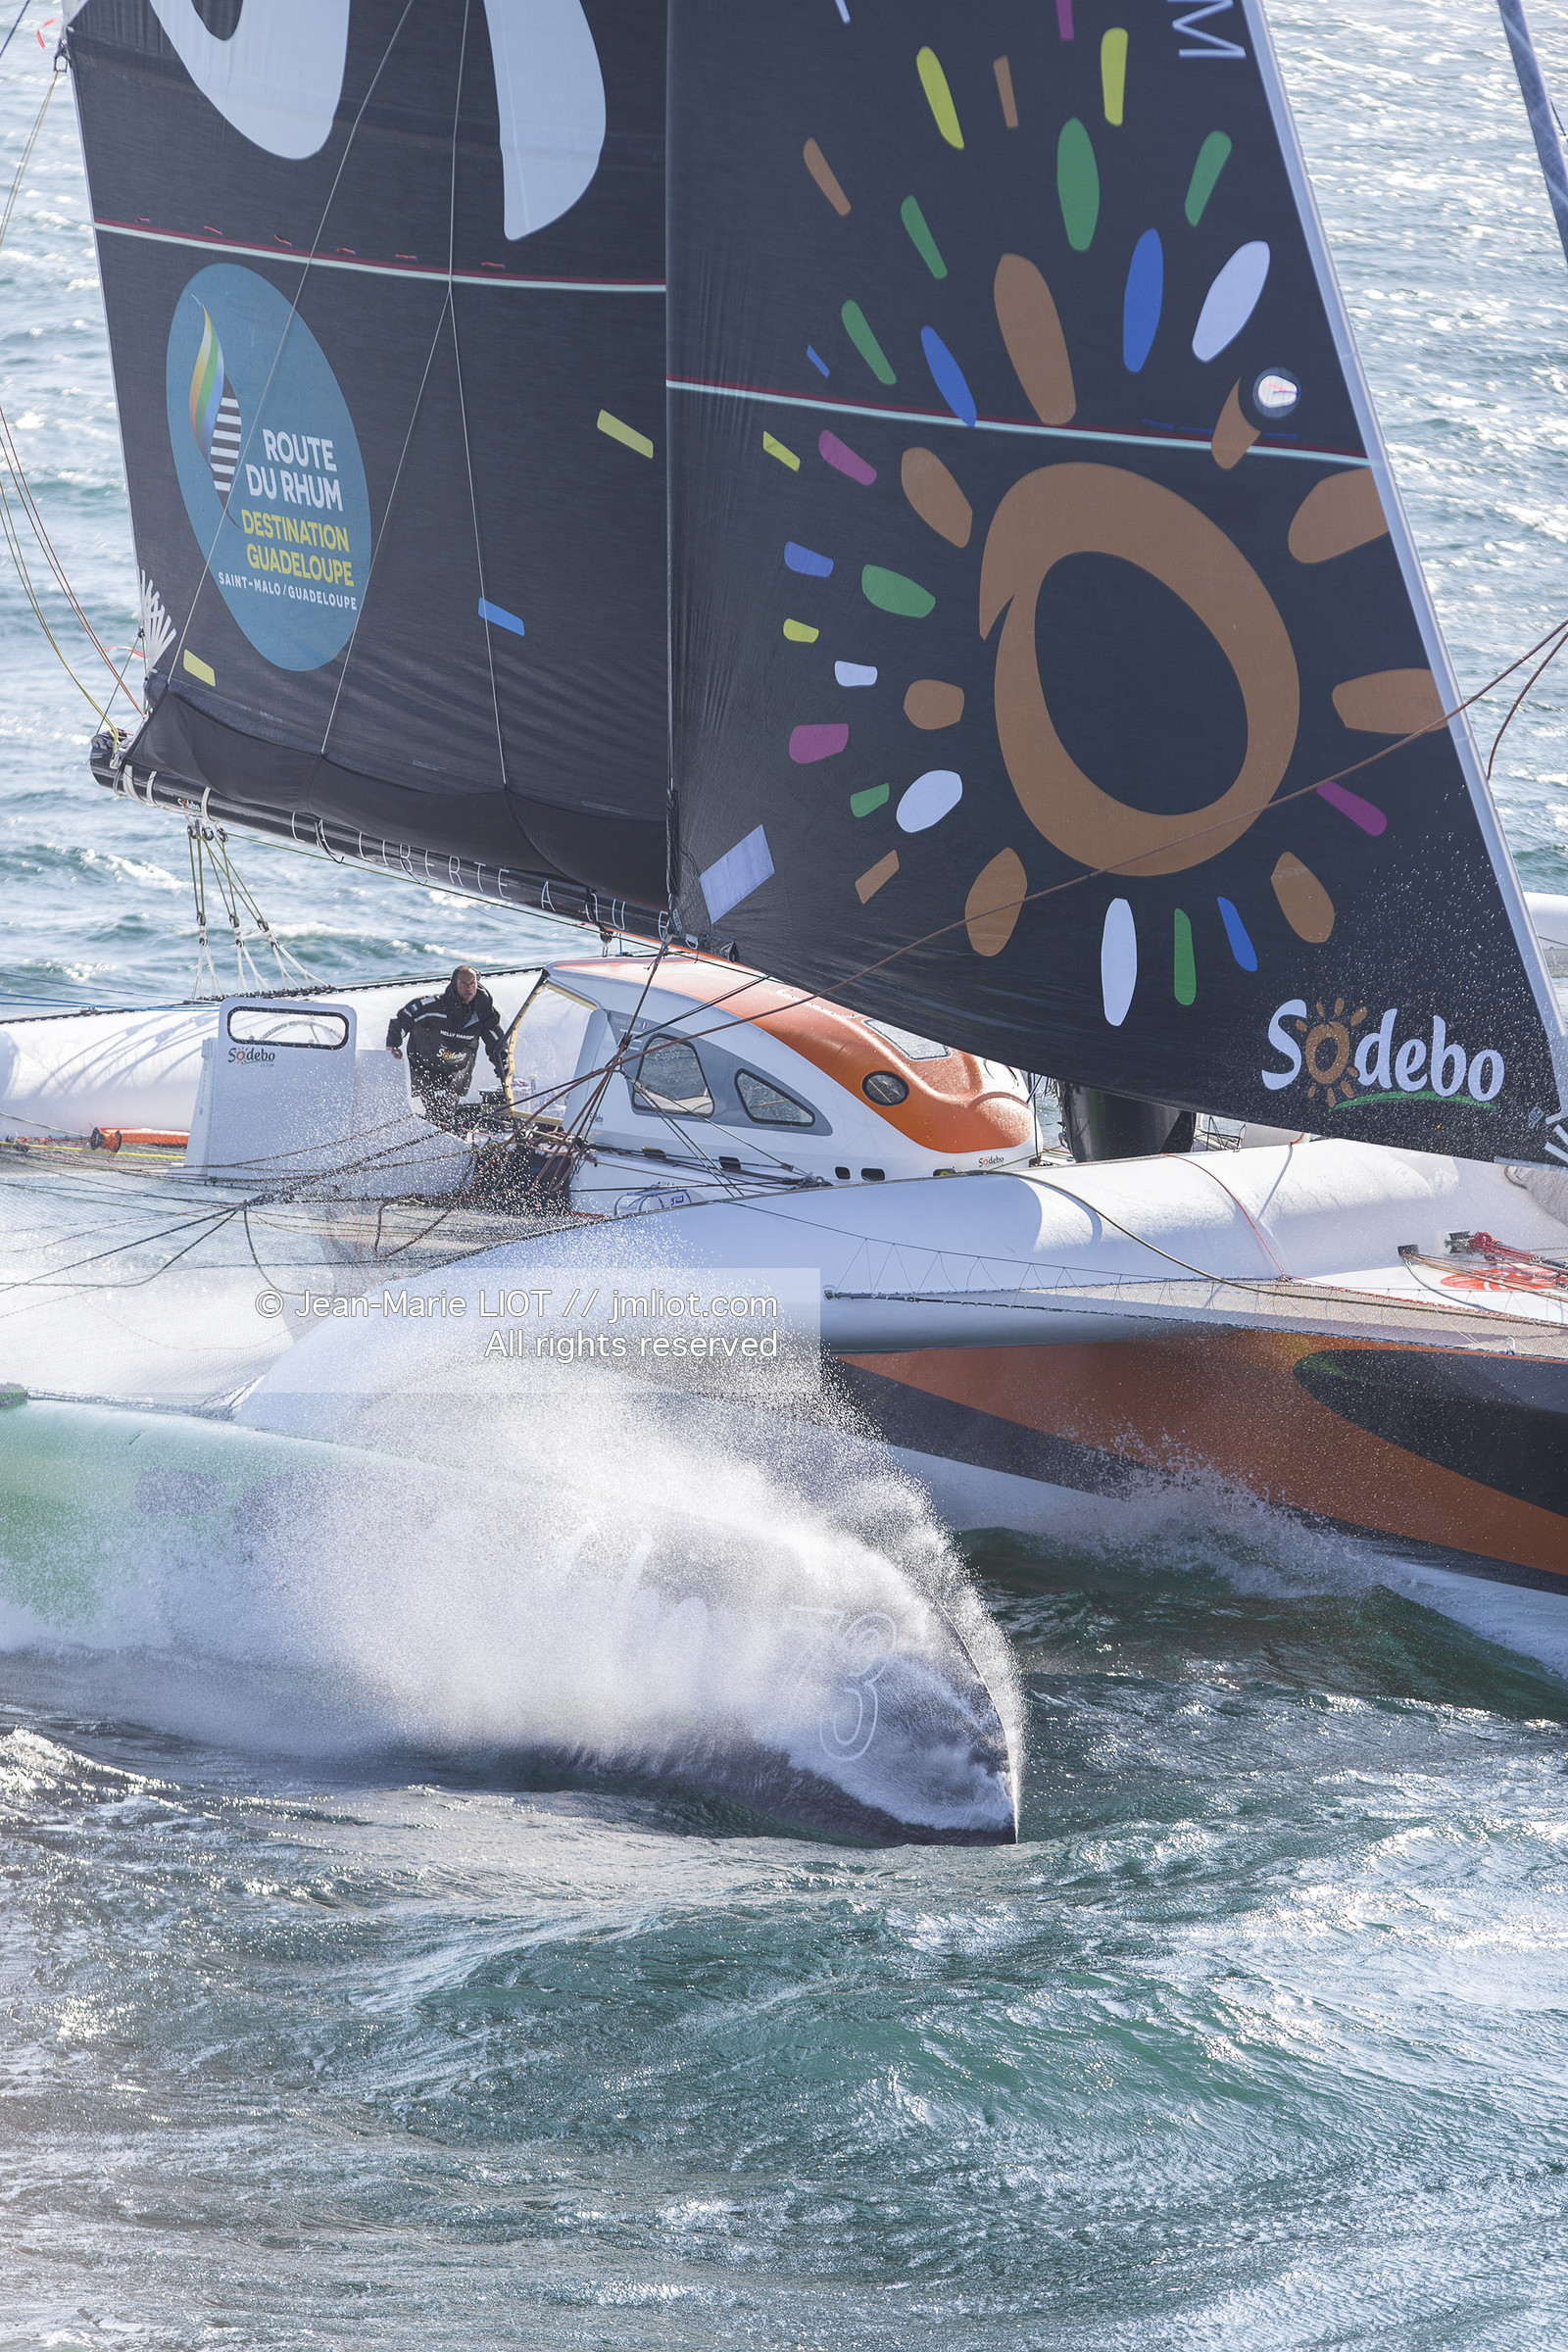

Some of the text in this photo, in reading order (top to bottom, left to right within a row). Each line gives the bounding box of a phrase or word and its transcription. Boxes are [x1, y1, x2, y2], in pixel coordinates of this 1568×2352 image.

[262, 428, 338, 472] ROUTE
[245, 464, 343, 513] DU RHUM
[241, 509, 350, 553] DESTINATION
[246, 543, 355, 588] GUADELOUPE
[540, 880, 557, 912] A
[227, 1046, 276, 1064] Sodebo
[439, 1029, 456, 1039] HELLY
[1261, 998, 1505, 1105] Sodebo
[978, 1154, 1004, 1168] Sodebo
